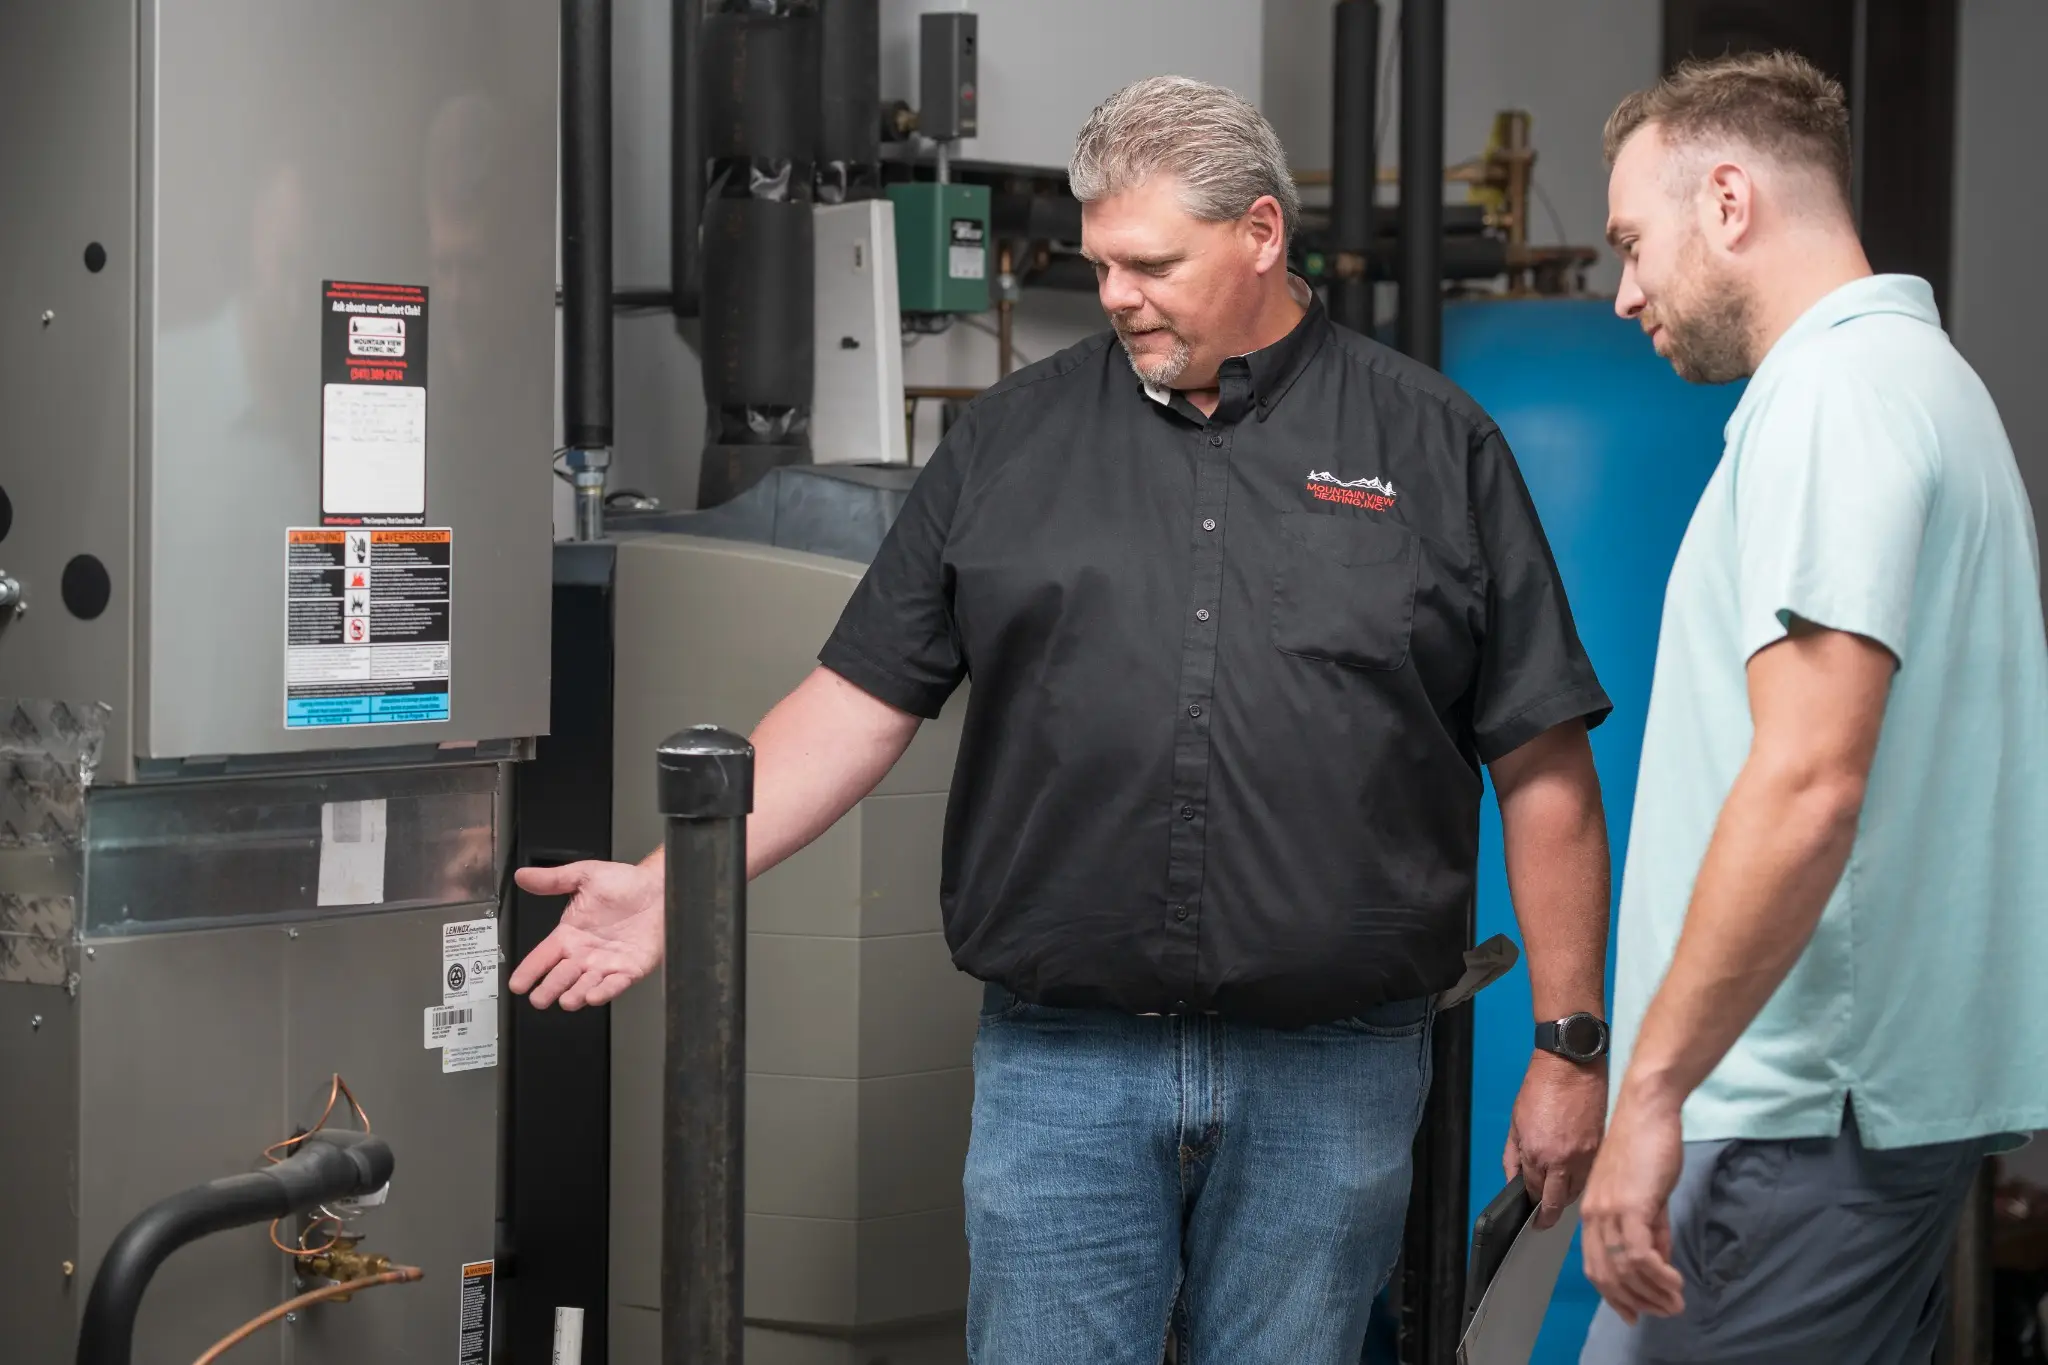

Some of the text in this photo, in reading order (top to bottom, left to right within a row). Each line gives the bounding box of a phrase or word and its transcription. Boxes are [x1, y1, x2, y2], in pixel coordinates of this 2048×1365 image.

[332, 300, 345, 312] Ask
[346, 301, 366, 313] about
[366, 304, 378, 314] our
[378, 303, 404, 315] Comfort
[354, 338, 386, 346] MOUNTAIN
[1306, 483, 1395, 507] MOUNTAIN VIEW
[302, 531, 342, 542] WARNING
[384, 531, 446, 542] AVERTISSEMENT
[445, 924, 470, 935] LENNOX
[469, 1265, 492, 1275] WARNING
